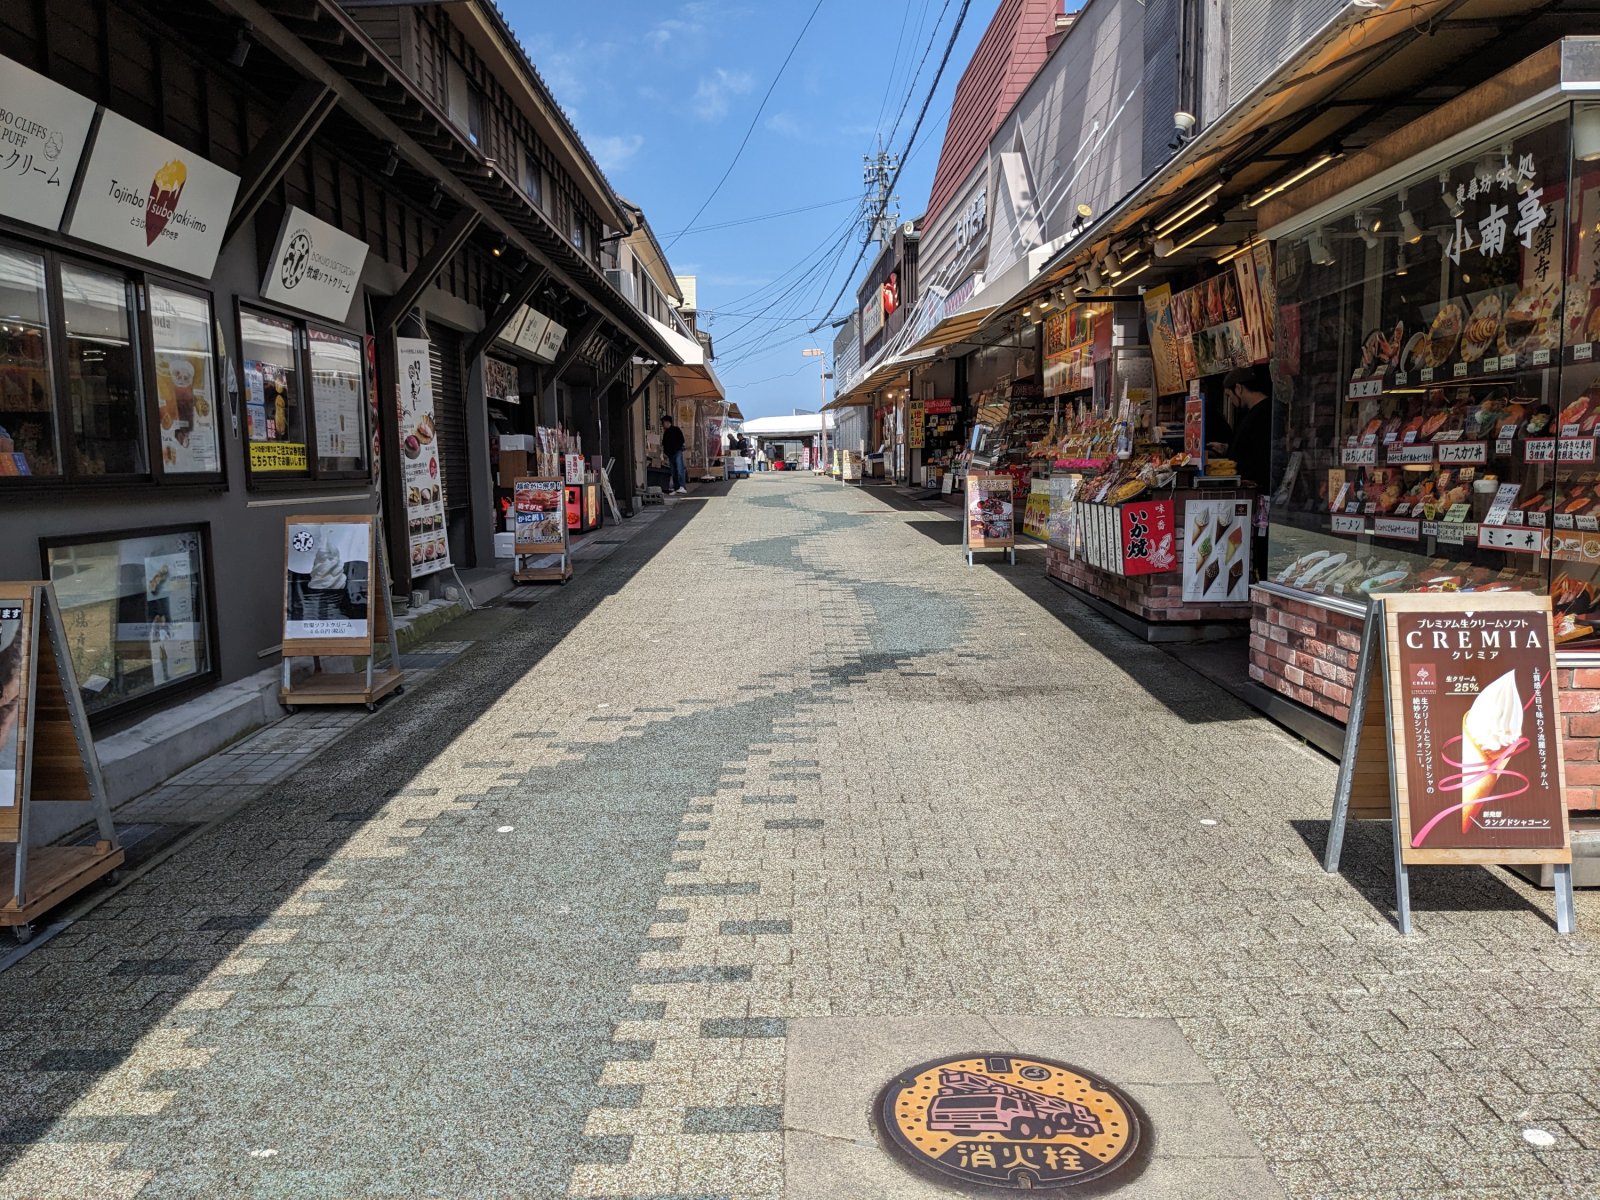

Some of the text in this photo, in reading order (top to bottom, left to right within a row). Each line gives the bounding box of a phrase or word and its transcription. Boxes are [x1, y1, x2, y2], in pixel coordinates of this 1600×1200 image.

[15, 116, 48, 139] CLIFFS
[1, 128, 28, 147] PUFF
[1455, 152, 1537, 206] 東尋坊味処
[109, 179, 207, 233] Tojinbo Tsuboyaki-imo
[1445, 187, 1547, 267] 小南亭
[306, 265, 351, 293] 牧場ソフトクリーム
[1353, 382, 1379, 396] うどん
[1441, 445, 1483, 460] ソースカツ丼
[1155, 503, 1166, 530] 味一番
[1335, 518, 1361, 531] ラーメン
[1126, 509, 1149, 559] いか焼
[1488, 531, 1535, 549] ミニ丼
[1417, 618, 1529, 629] プレミアム生クリームソフト
[1406, 630, 1542, 649] CREMIA
[1451, 651, 1499, 660] クレミア
[1445, 675, 1477, 683] 生クリーム
[1454, 682, 1479, 692] 25%
[1412, 697, 1425, 768] 絶妙なシンフォニー。
[1420, 697, 1435, 794] 生クリームとラングドシャの
[1484, 818, 1550, 826] ラングドシャコーン
[955, 1143, 1085, 1171] 消火栓
